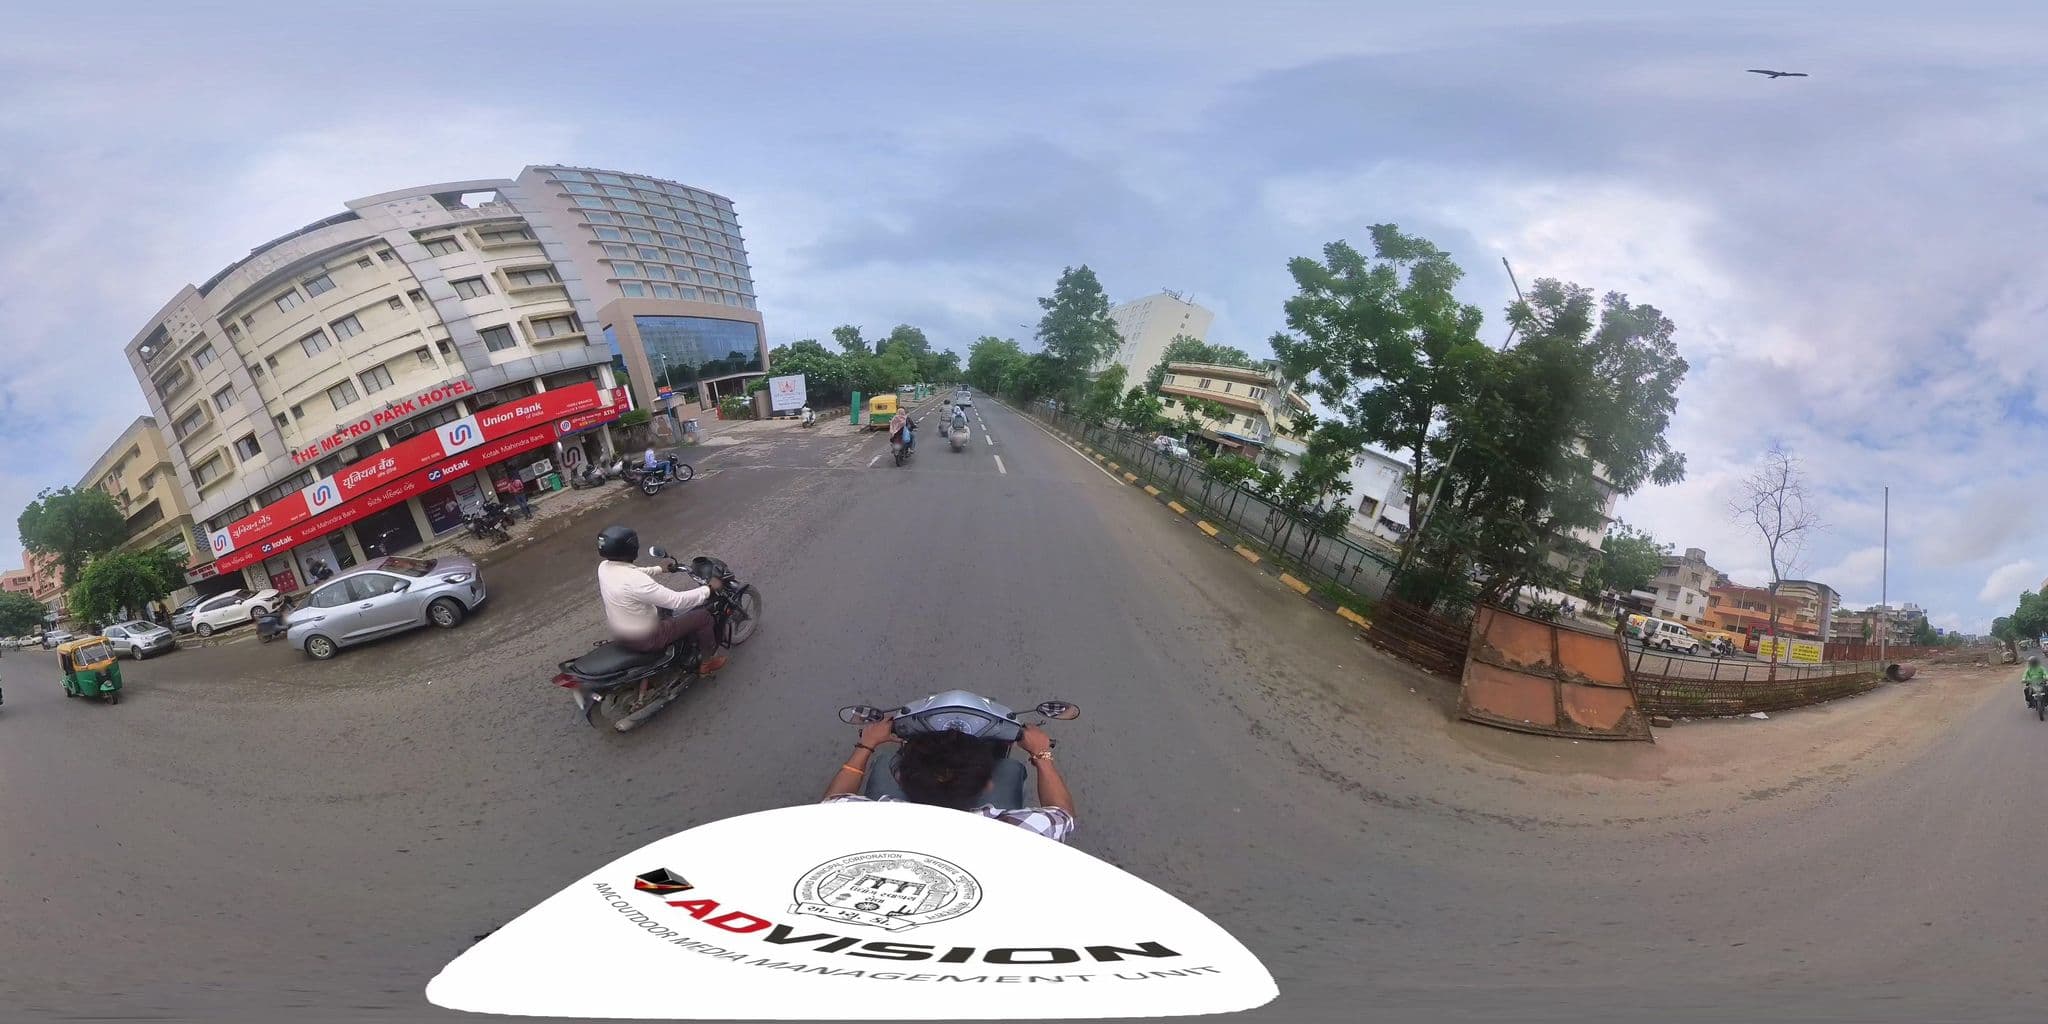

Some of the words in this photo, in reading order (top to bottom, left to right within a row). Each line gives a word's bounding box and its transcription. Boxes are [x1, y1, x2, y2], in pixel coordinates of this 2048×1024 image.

[292, 444, 320, 465] THE
[321, 419, 371, 452] METRO
[373, 400, 417, 427] PARK
[417, 380, 474, 408] HOTEL
[482, 409, 514, 427] Union
[515, 402, 542, 417] Bank
[441, 459, 470, 476] kotak
[481, 450, 500, 460] Kotak
[500, 439, 530, 453] Mahindra
[530, 433, 544, 443] Bank
[342, 465, 377, 489] यूनियन
[271, 535, 293, 550] kotak
